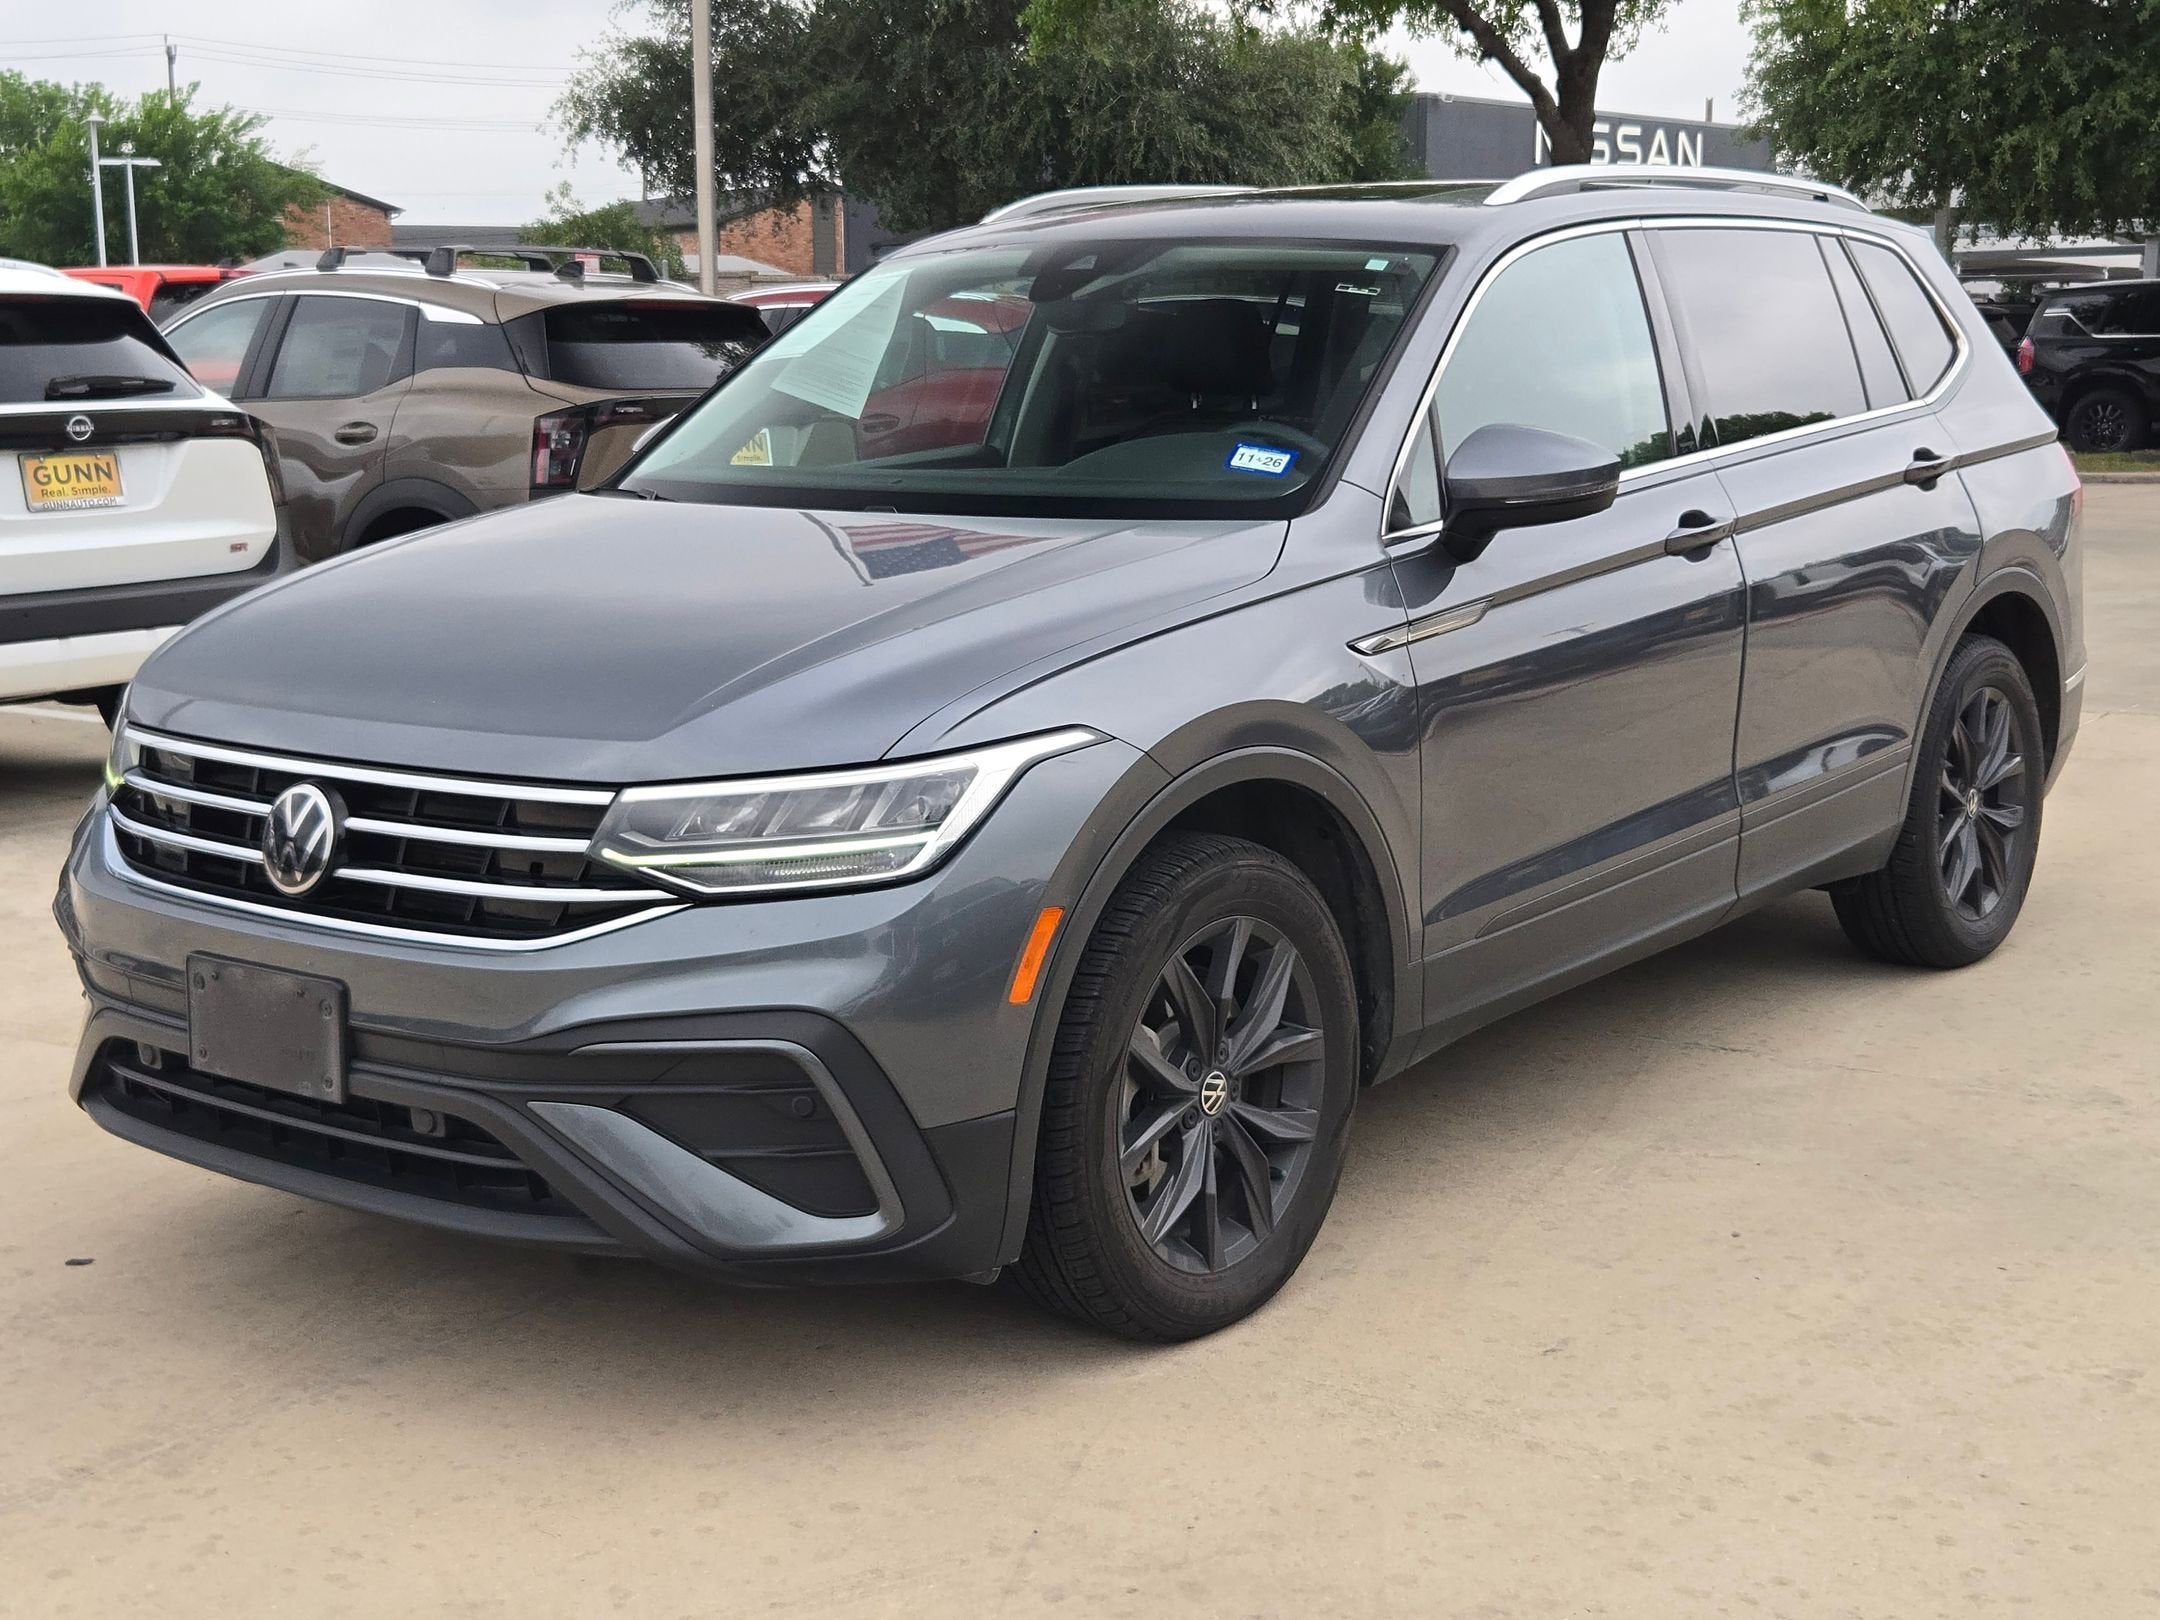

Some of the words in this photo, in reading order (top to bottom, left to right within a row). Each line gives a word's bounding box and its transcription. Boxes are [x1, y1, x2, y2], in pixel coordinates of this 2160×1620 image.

[1535, 118, 1703, 167] NSSAN
[33, 461, 114, 487] GUNN
[41, 487, 69, 499] Real.
[71, 485, 111, 498] Simple.
[43, 496, 118, 510] GUNNAUTO.COM
